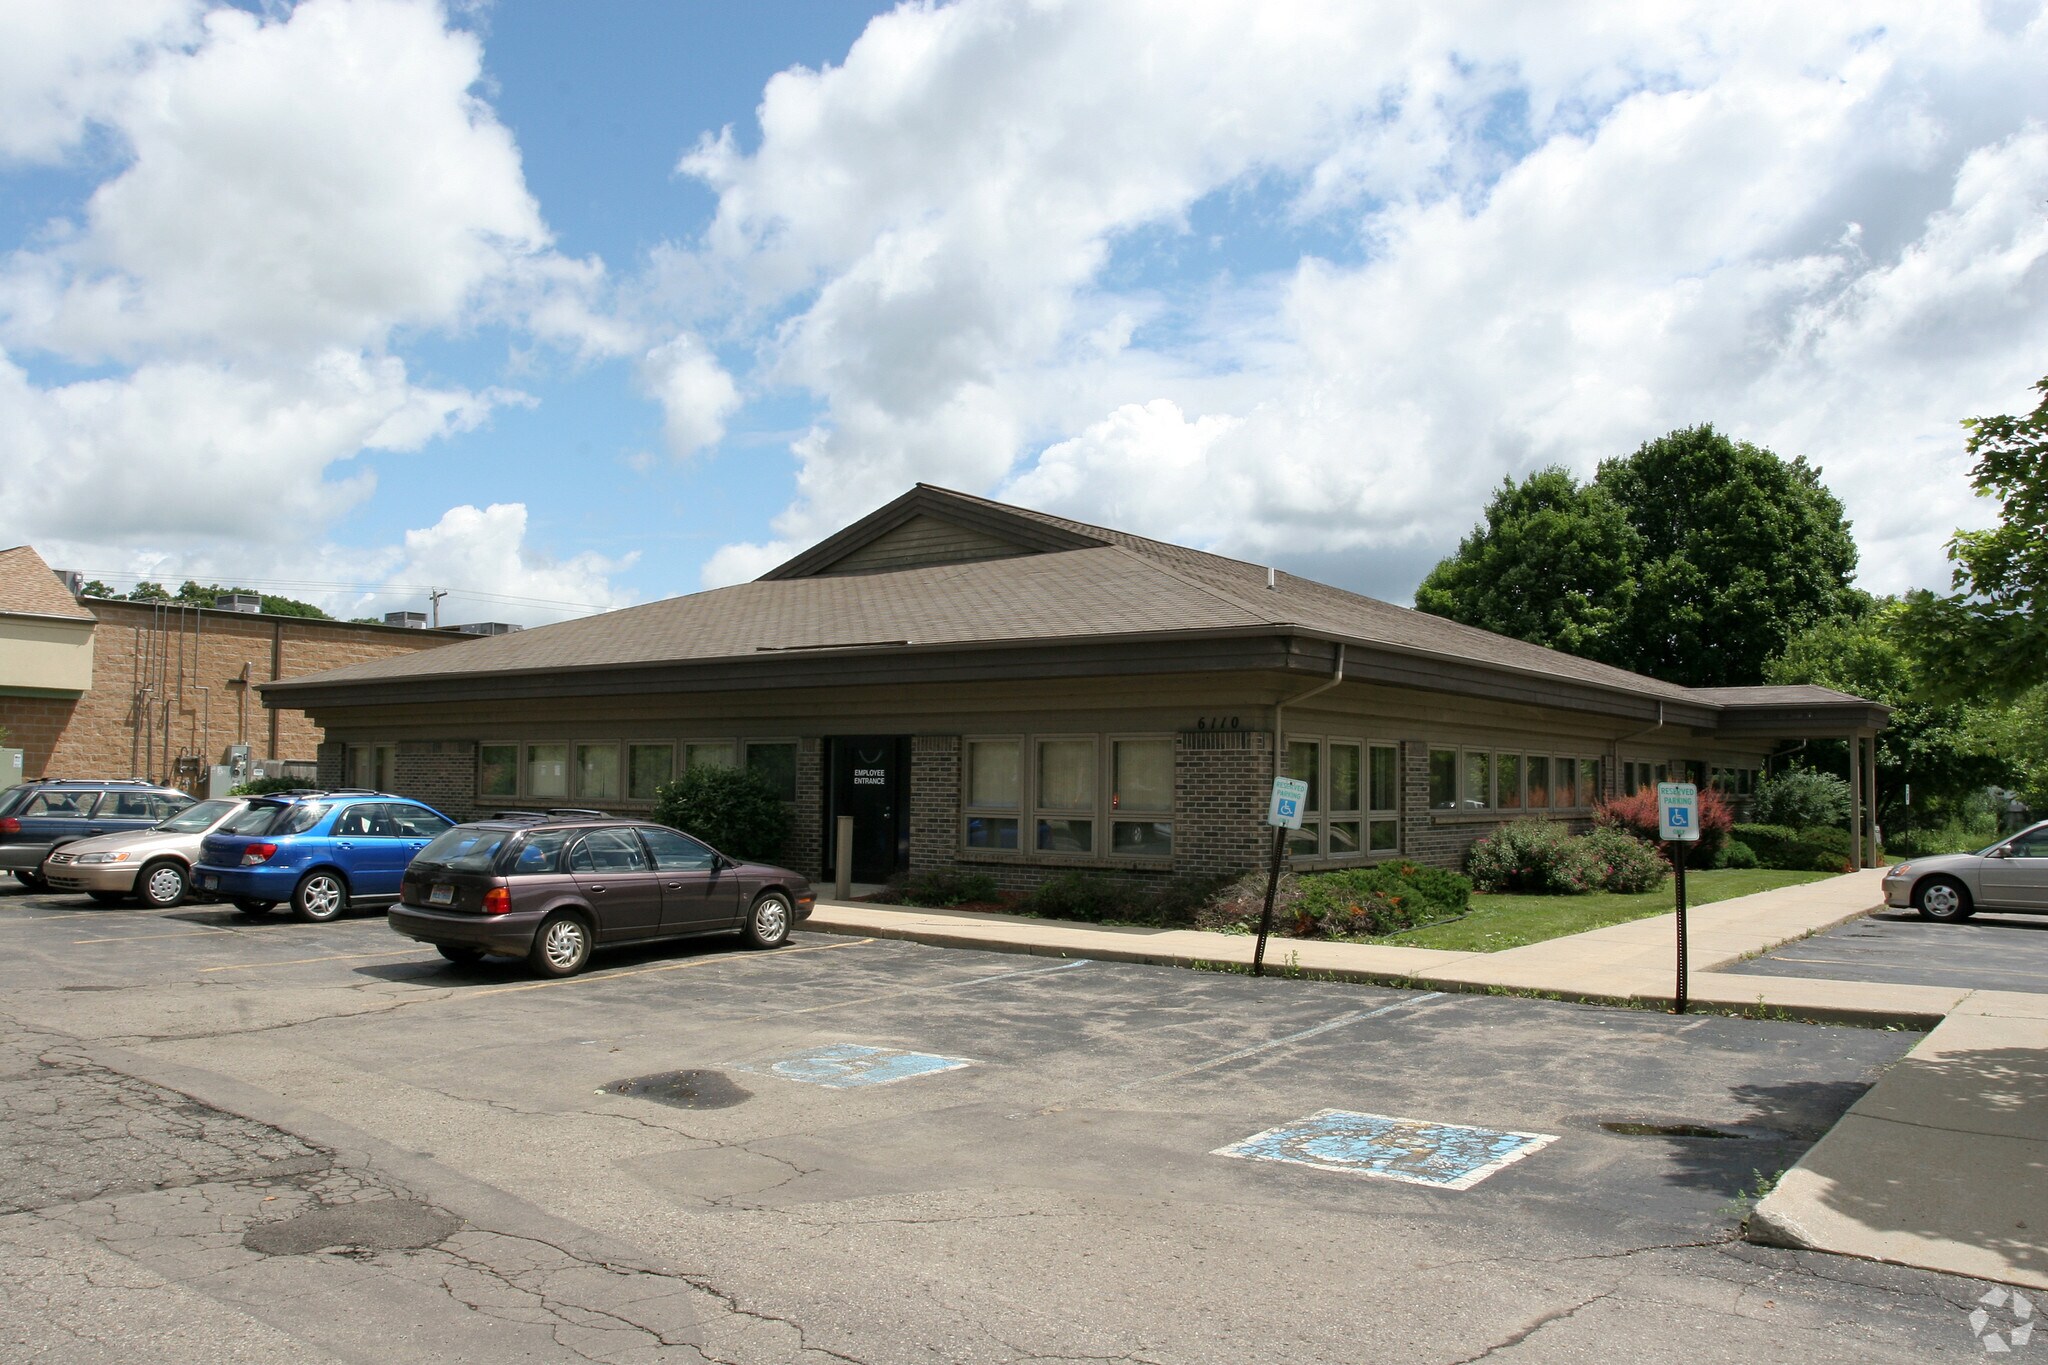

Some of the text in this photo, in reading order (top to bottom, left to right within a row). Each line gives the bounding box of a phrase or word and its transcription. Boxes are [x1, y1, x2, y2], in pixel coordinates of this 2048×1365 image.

[1197, 716, 1239, 730] 6110
[1276, 781, 1305, 792] RESERVED
[1660, 787, 1694, 796] RESERVED
[1277, 790, 1302, 800] PARKING
[1664, 797, 1692, 805] PARKING
